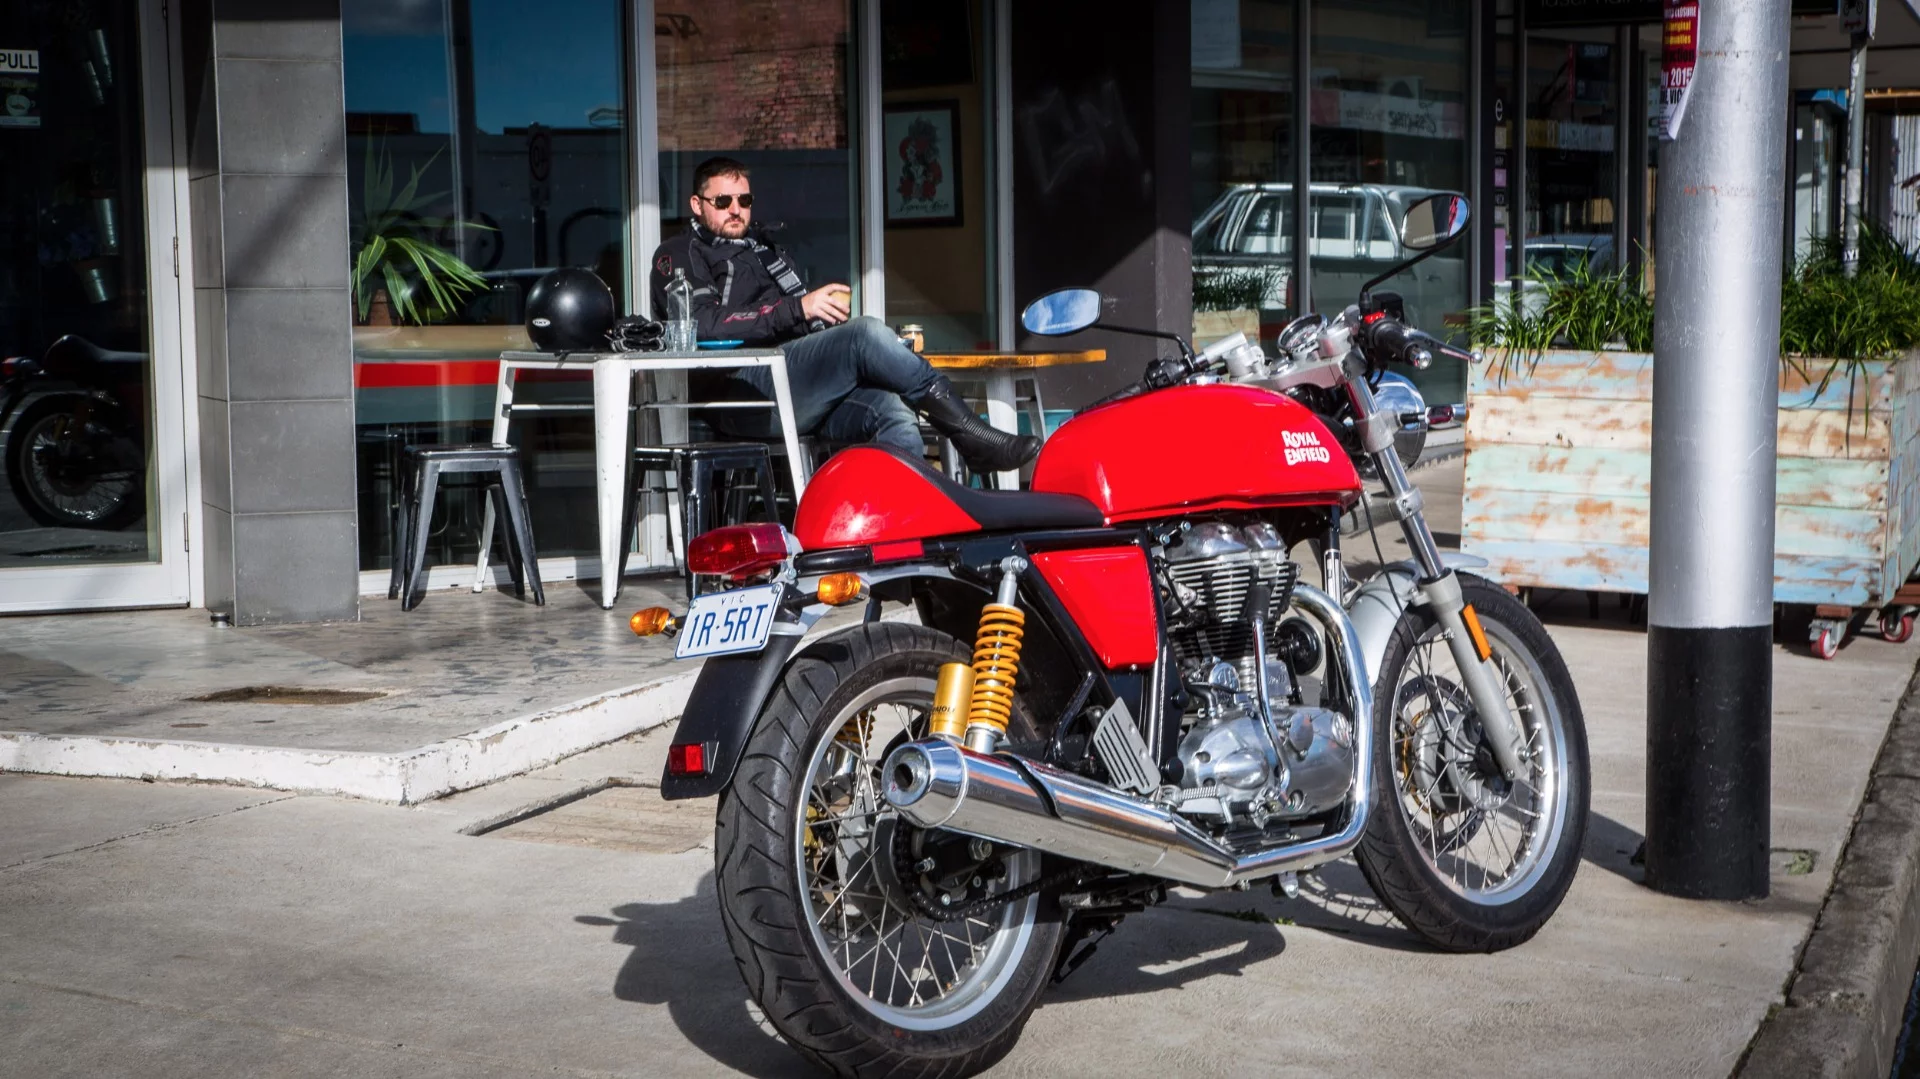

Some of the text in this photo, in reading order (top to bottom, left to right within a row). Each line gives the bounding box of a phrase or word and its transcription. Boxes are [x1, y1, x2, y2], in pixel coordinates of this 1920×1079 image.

[0, 53, 37, 69] PULL
[1671, 67, 1693, 86] 2015
[1281, 430, 1320, 448] ROYAL
[1284, 447, 1330, 466] ENFIELD
[721, 594, 745, 606] VIC
